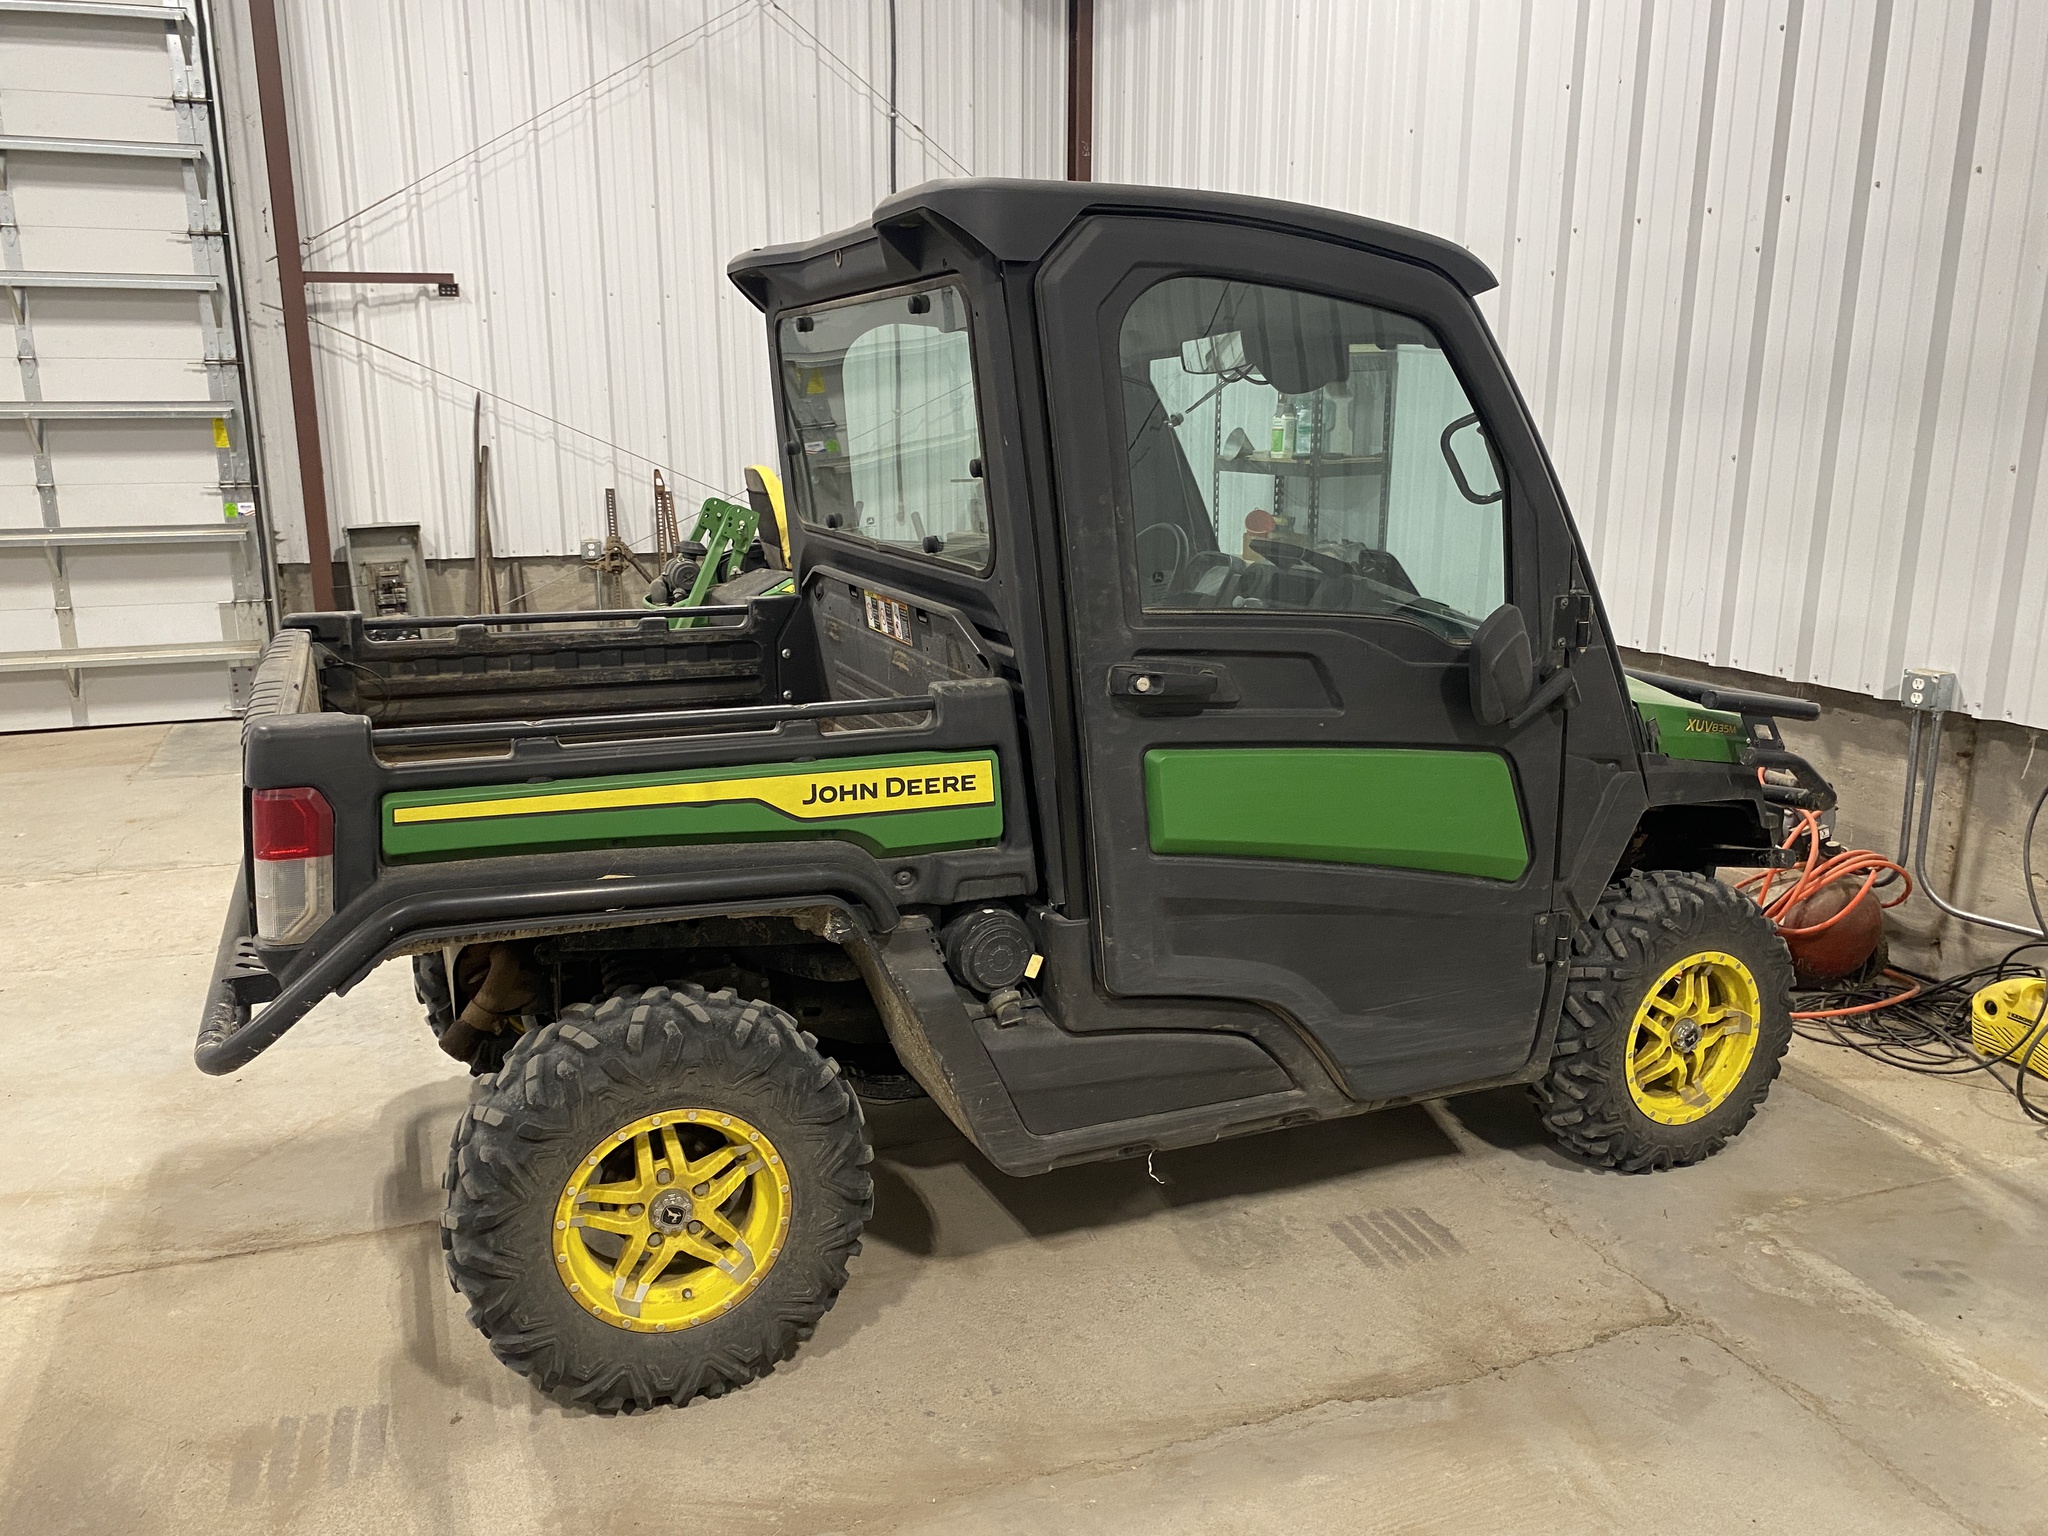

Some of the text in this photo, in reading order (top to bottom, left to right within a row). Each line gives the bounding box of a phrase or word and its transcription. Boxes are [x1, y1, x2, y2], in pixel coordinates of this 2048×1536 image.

[1685, 718, 1737, 734] XUV835M
[802, 774, 976, 805] JOHN DEERE
